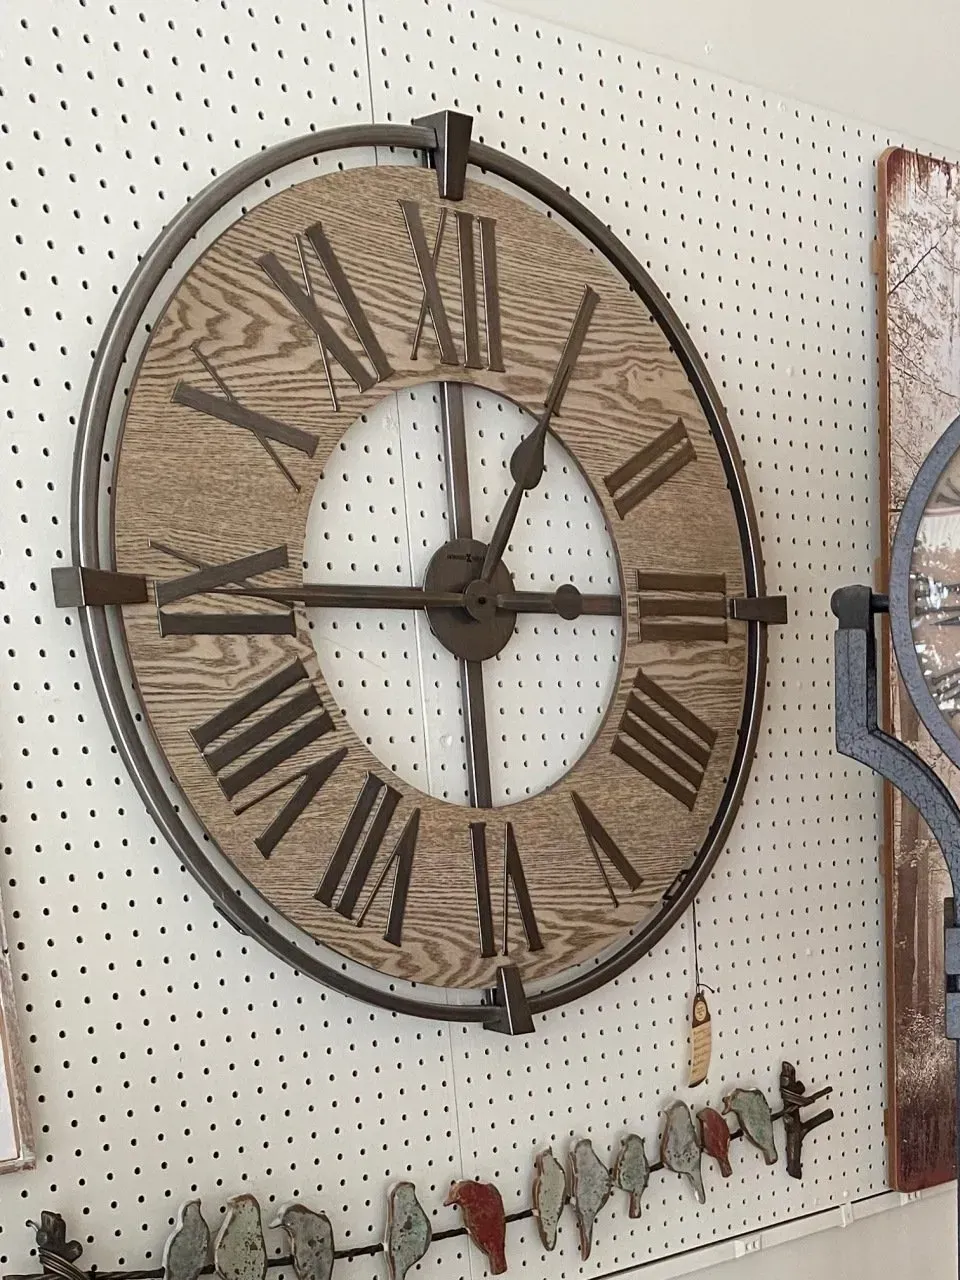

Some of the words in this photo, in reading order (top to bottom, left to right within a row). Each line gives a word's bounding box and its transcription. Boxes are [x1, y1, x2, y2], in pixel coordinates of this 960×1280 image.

[254, 221, 396, 413] XI
[397, 199, 506, 373] XII
[170, 344, 321, 491] X
[602, 416, 698, 520] II
[635, 568, 729, 644] III
[312, 770, 421, 948] VII
[468, 821, 545, 959] VI
[569, 790, 645, 908] V
